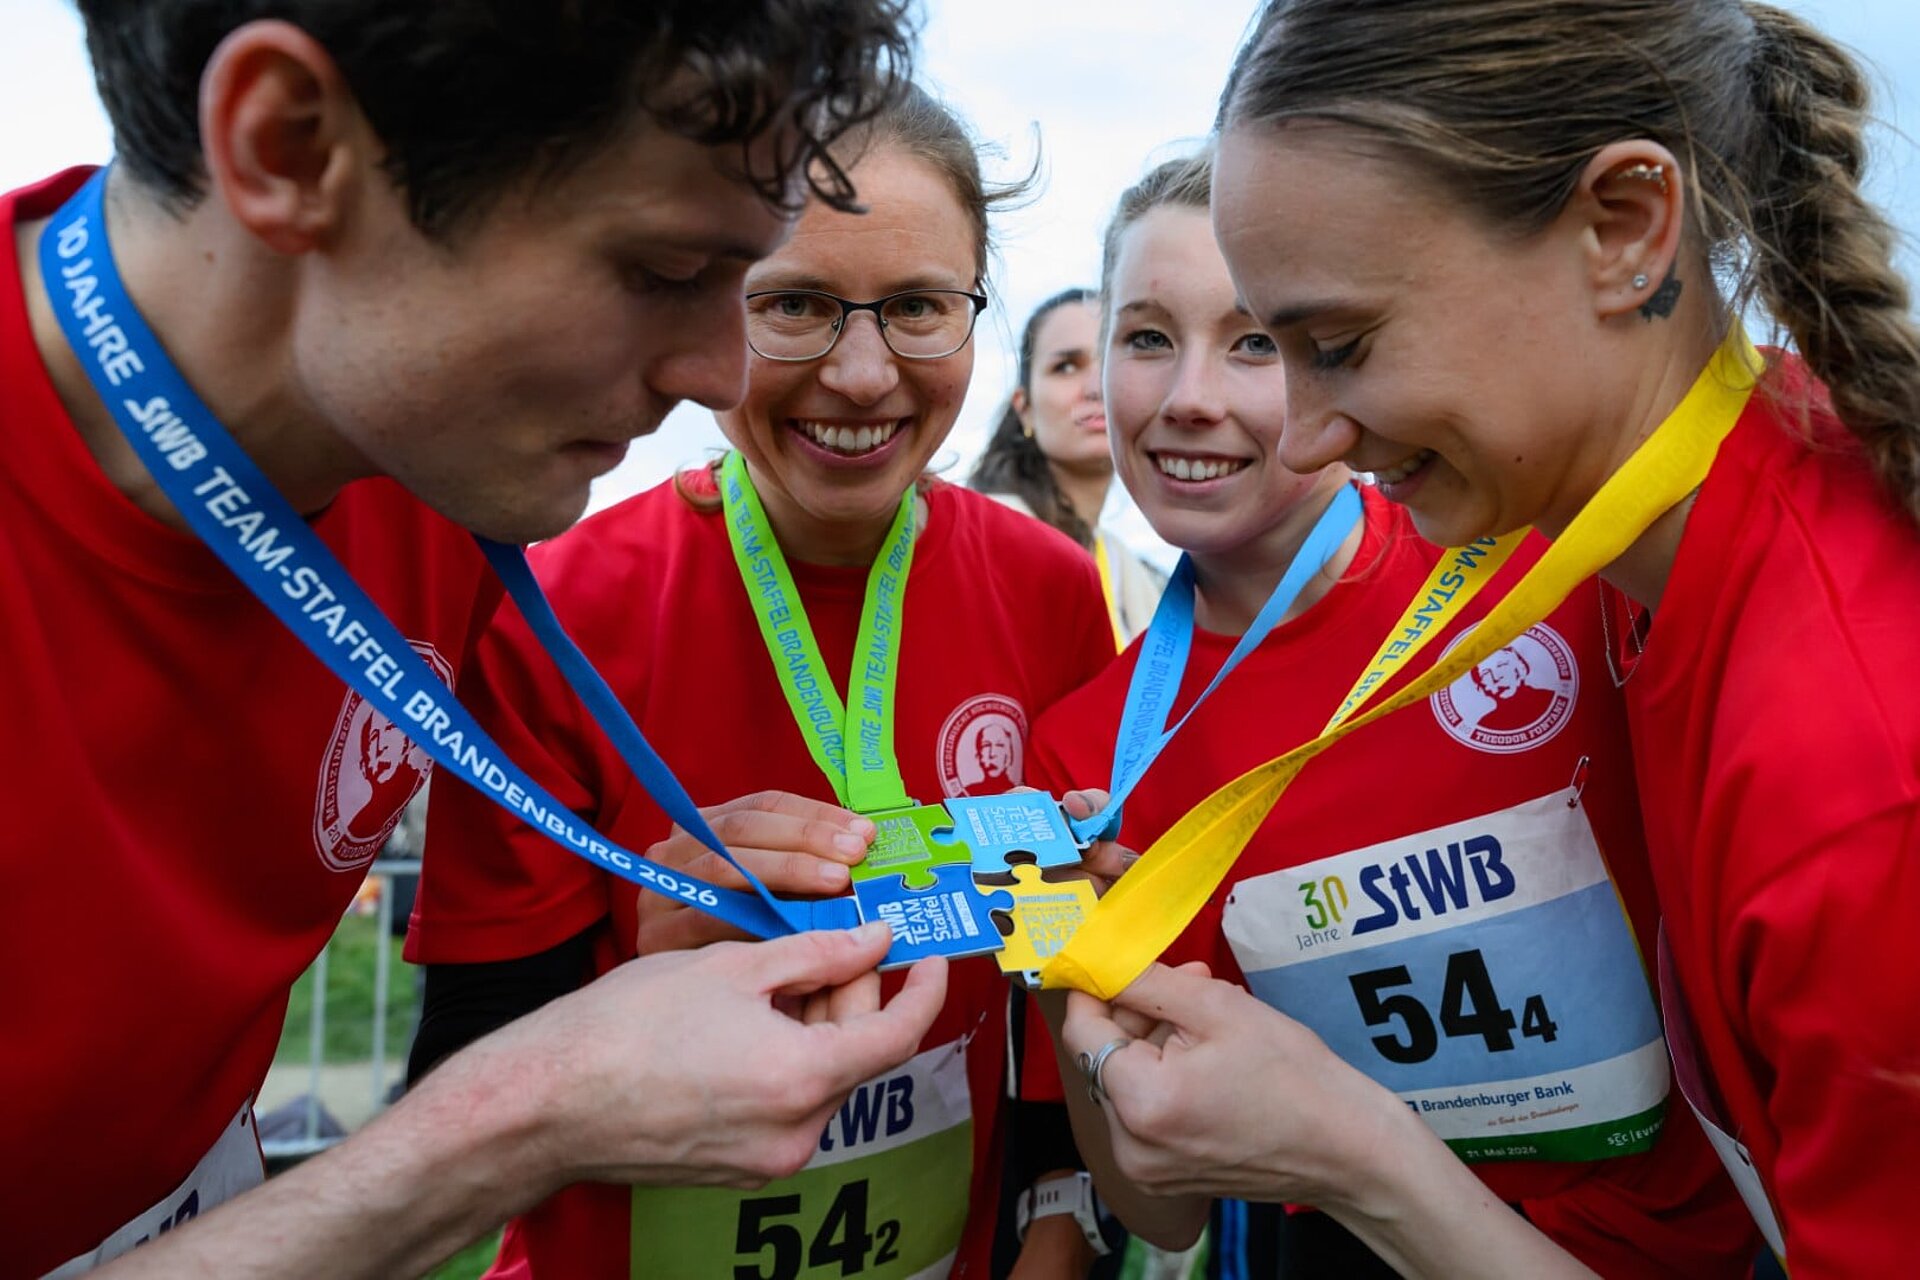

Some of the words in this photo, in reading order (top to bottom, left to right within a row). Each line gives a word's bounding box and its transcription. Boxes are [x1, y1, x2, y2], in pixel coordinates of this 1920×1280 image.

[57, 216, 89, 259] 10
[61, 257, 145, 387] JAHRE
[124, 396, 208, 471] StWB
[193, 466, 406, 702] TEAM-STAFFEL
[735, 501, 790, 630] TEAM-STAFFEL
[1475, 730, 1528, 745] THEODOR
[1529, 698, 1567, 738] FONTANE
[402, 690, 632, 871] BRANDENBURG
[991, 806, 1018, 844] Staffel
[1006, 805, 1035, 843] TEAM
[638, 864, 719, 907] 2026
[1297, 874, 1349, 930] 30
[1351, 834, 1517, 936] StWB
[902, 898, 932, 945] TEAM
[921, 895, 952, 943] Staffel
[1296, 926, 1342, 951] Jahre
[1347, 948, 1518, 1065] 54
[1520, 993, 1559, 1044] 4
[817, 1074, 915, 1152] tWB
[1421, 1089, 1531, 1113] Brandenburger
[1534, 1081, 1575, 1100] Bank
[732, 1178, 873, 1280] 54
[873, 1218, 902, 1268] 2
